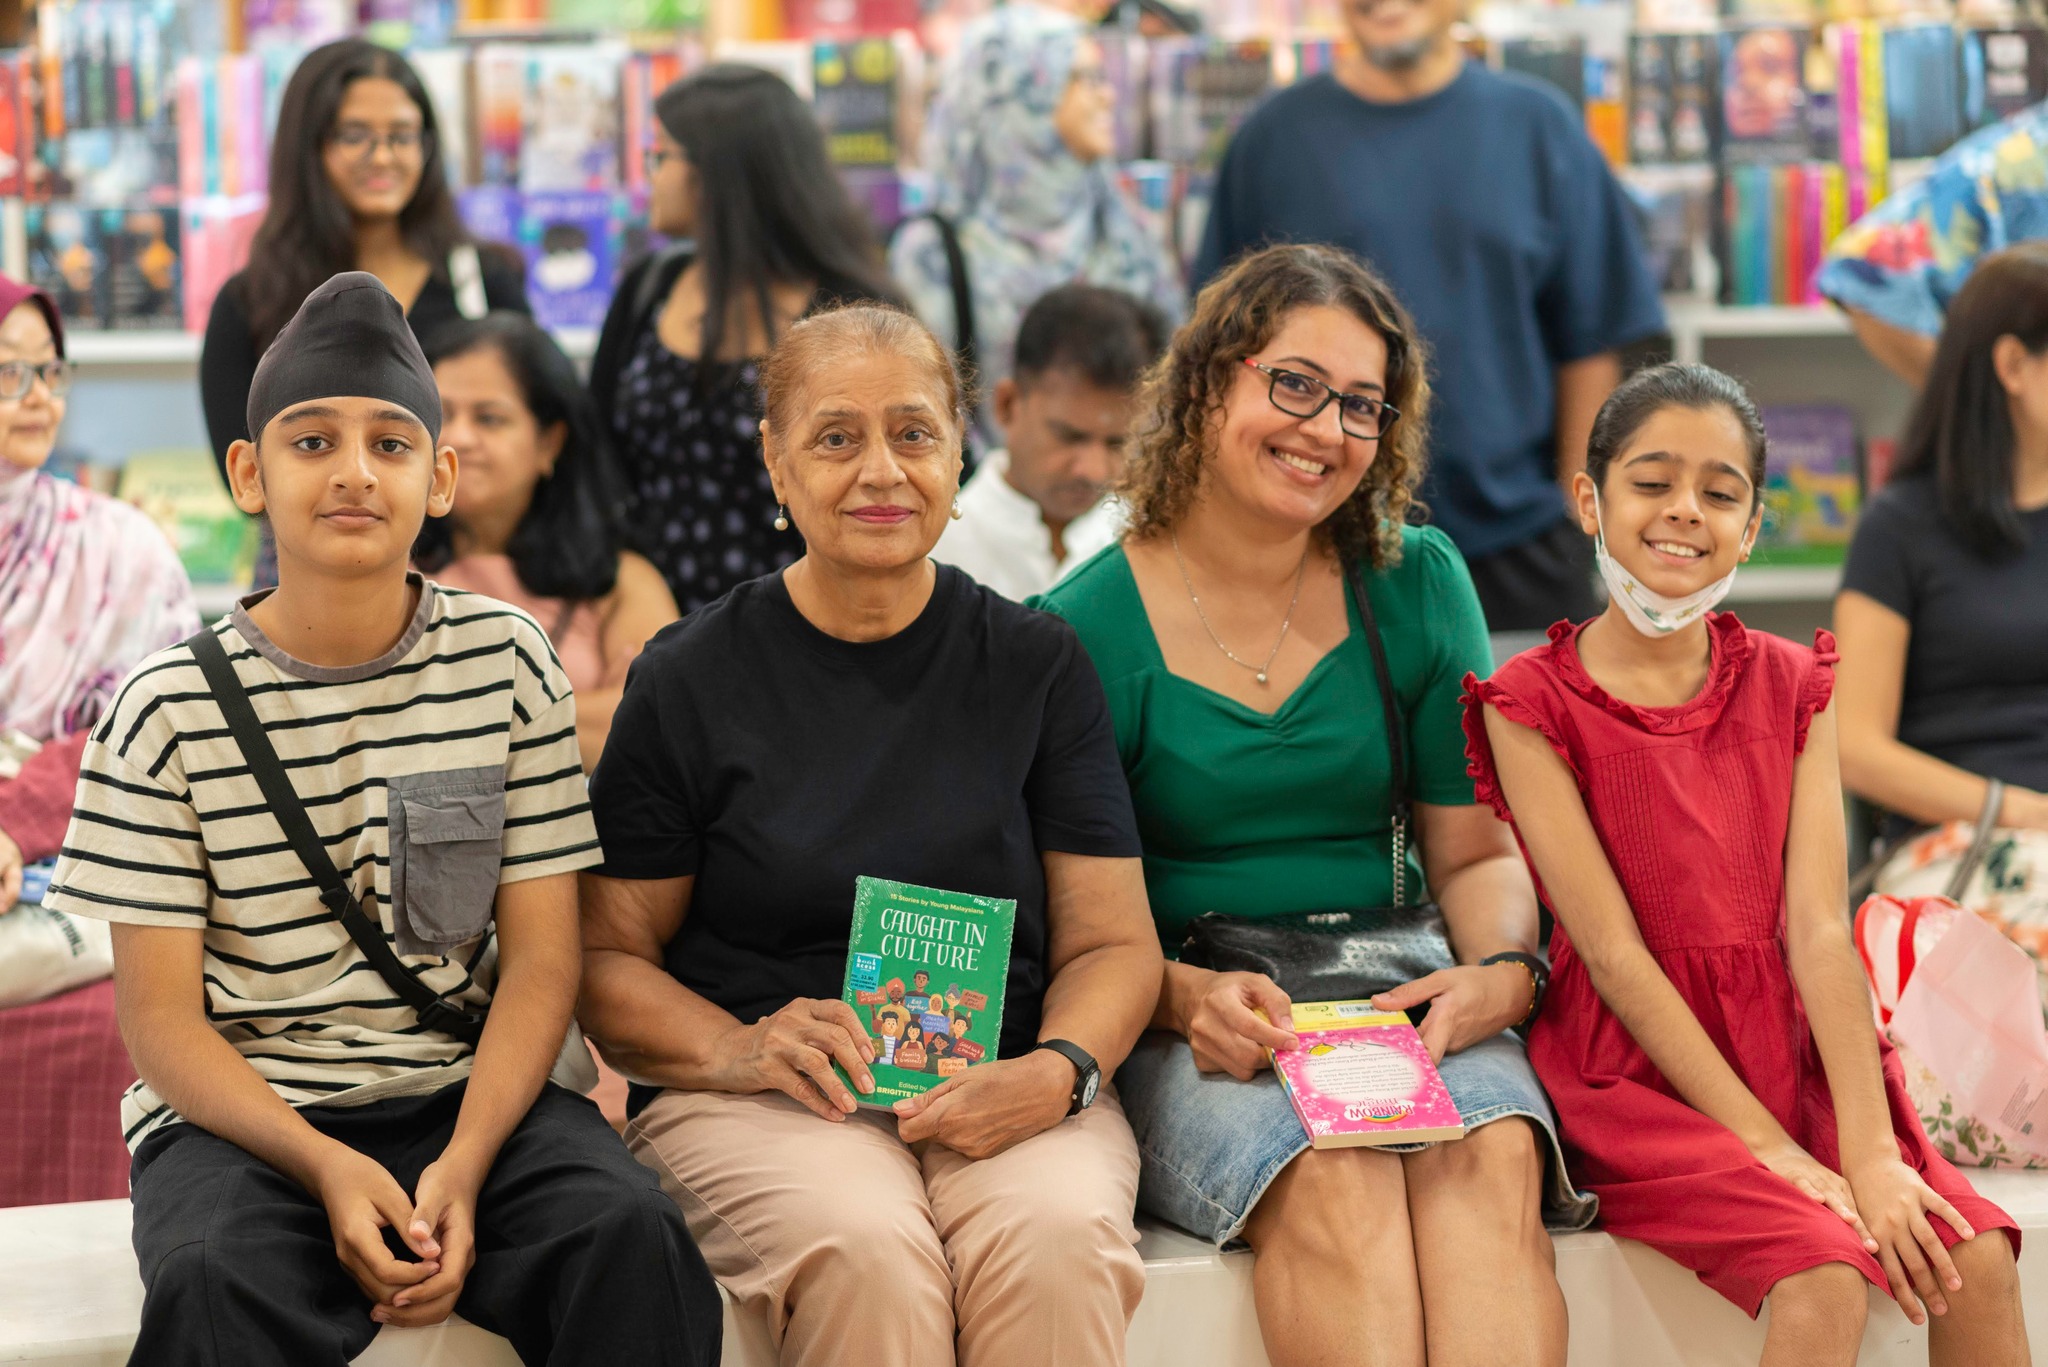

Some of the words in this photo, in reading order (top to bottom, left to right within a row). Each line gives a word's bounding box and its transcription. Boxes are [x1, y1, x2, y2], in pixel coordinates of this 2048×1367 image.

[899, 895, 920, 904] Stories
[921, 898, 929, 906] by
[930, 901, 950, 910] Young
[950, 905, 985, 915] Malaysians
[880, 908, 961, 942] CAUGHT
[963, 921, 988, 947] IN
[881, 934, 981, 971] CULTURE
[876, 1086, 912, 1098] BRIGITTE
[898, 1081, 919, 1090] Edited
[1349, 1104, 1414, 1120] RAINBOW
